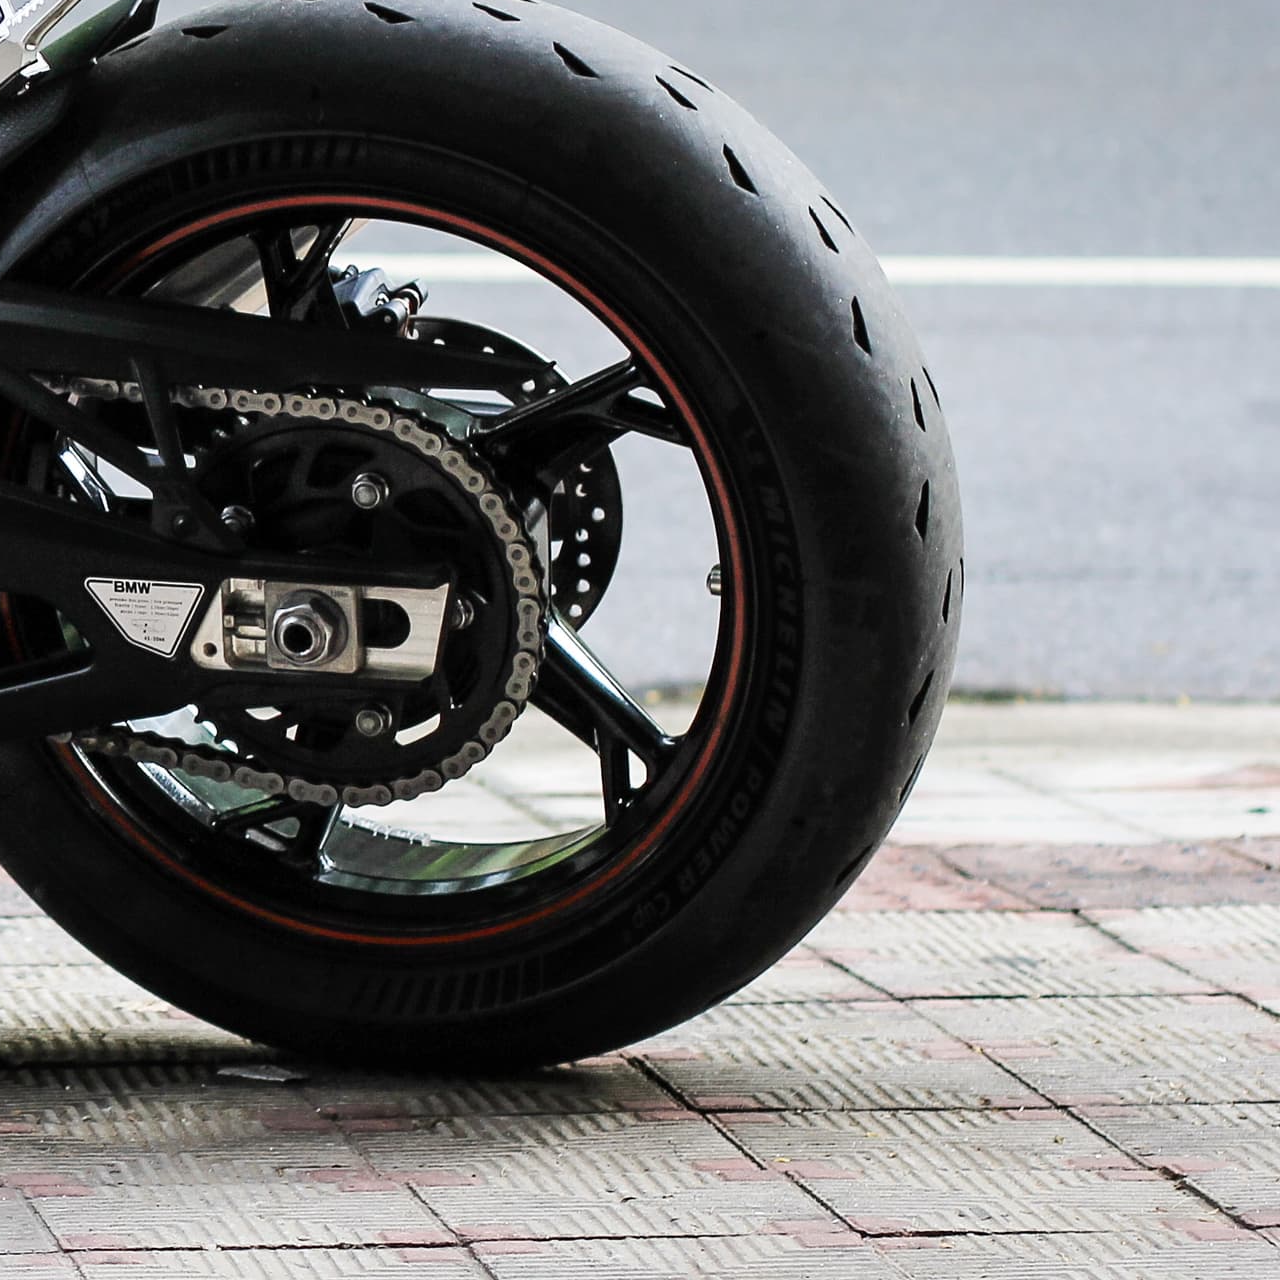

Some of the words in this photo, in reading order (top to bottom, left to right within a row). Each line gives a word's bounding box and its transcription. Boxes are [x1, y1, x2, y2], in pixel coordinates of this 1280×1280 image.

[113, 580, 152, 595] BMW
[759, 485, 798, 736] MICHELIN
[676, 762, 764, 895] POWER
